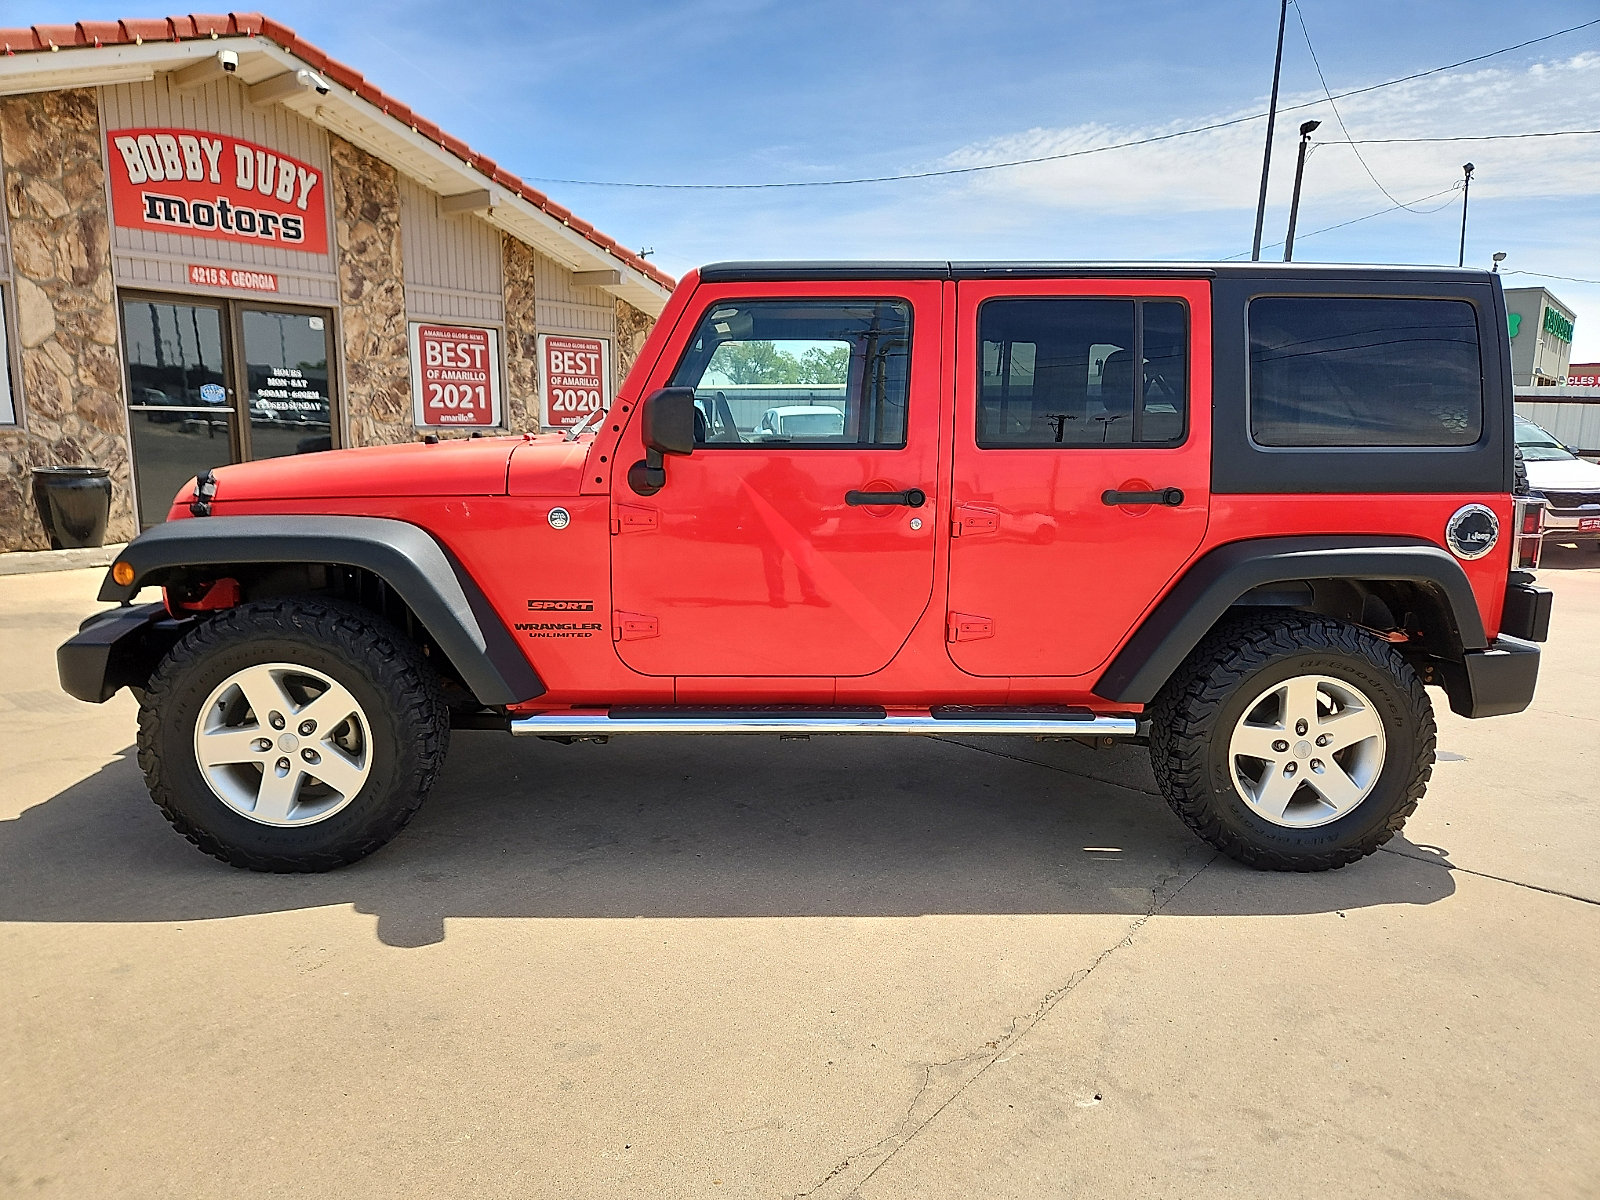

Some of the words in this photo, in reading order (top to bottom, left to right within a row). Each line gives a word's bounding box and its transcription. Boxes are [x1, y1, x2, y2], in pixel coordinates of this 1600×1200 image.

[114, 133, 222, 184] BOBBY
[235, 144, 317, 210] DUBY
[142, 192, 304, 243] motors
[219, 269, 230, 286] S.
[231, 271, 275, 290] GEORGIA
[424, 330, 451, 338] AMARILLO
[549, 341, 571, 349] AMARILLO
[425, 340, 485, 369] BEST
[550, 350, 599, 375] BEST
[273, 367, 302, 378] HOURS
[426, 369, 440, 379] OF
[441, 370, 486, 381] AMARILLO
[551, 376, 562, 385] OF
[562, 377, 600, 387] AMARILLO
[1567, 376, 1595, 385] CLES
[428, 383, 486, 409] 2021
[552, 388, 600, 411] 2020
[255, 401, 289, 411] CLOSED
[289, 401, 321, 411] SUNDAY
[440, 413, 469, 422] amarillo
[529, 600, 593, 611] SPORT
[514, 622, 603, 631] WRANGLER
